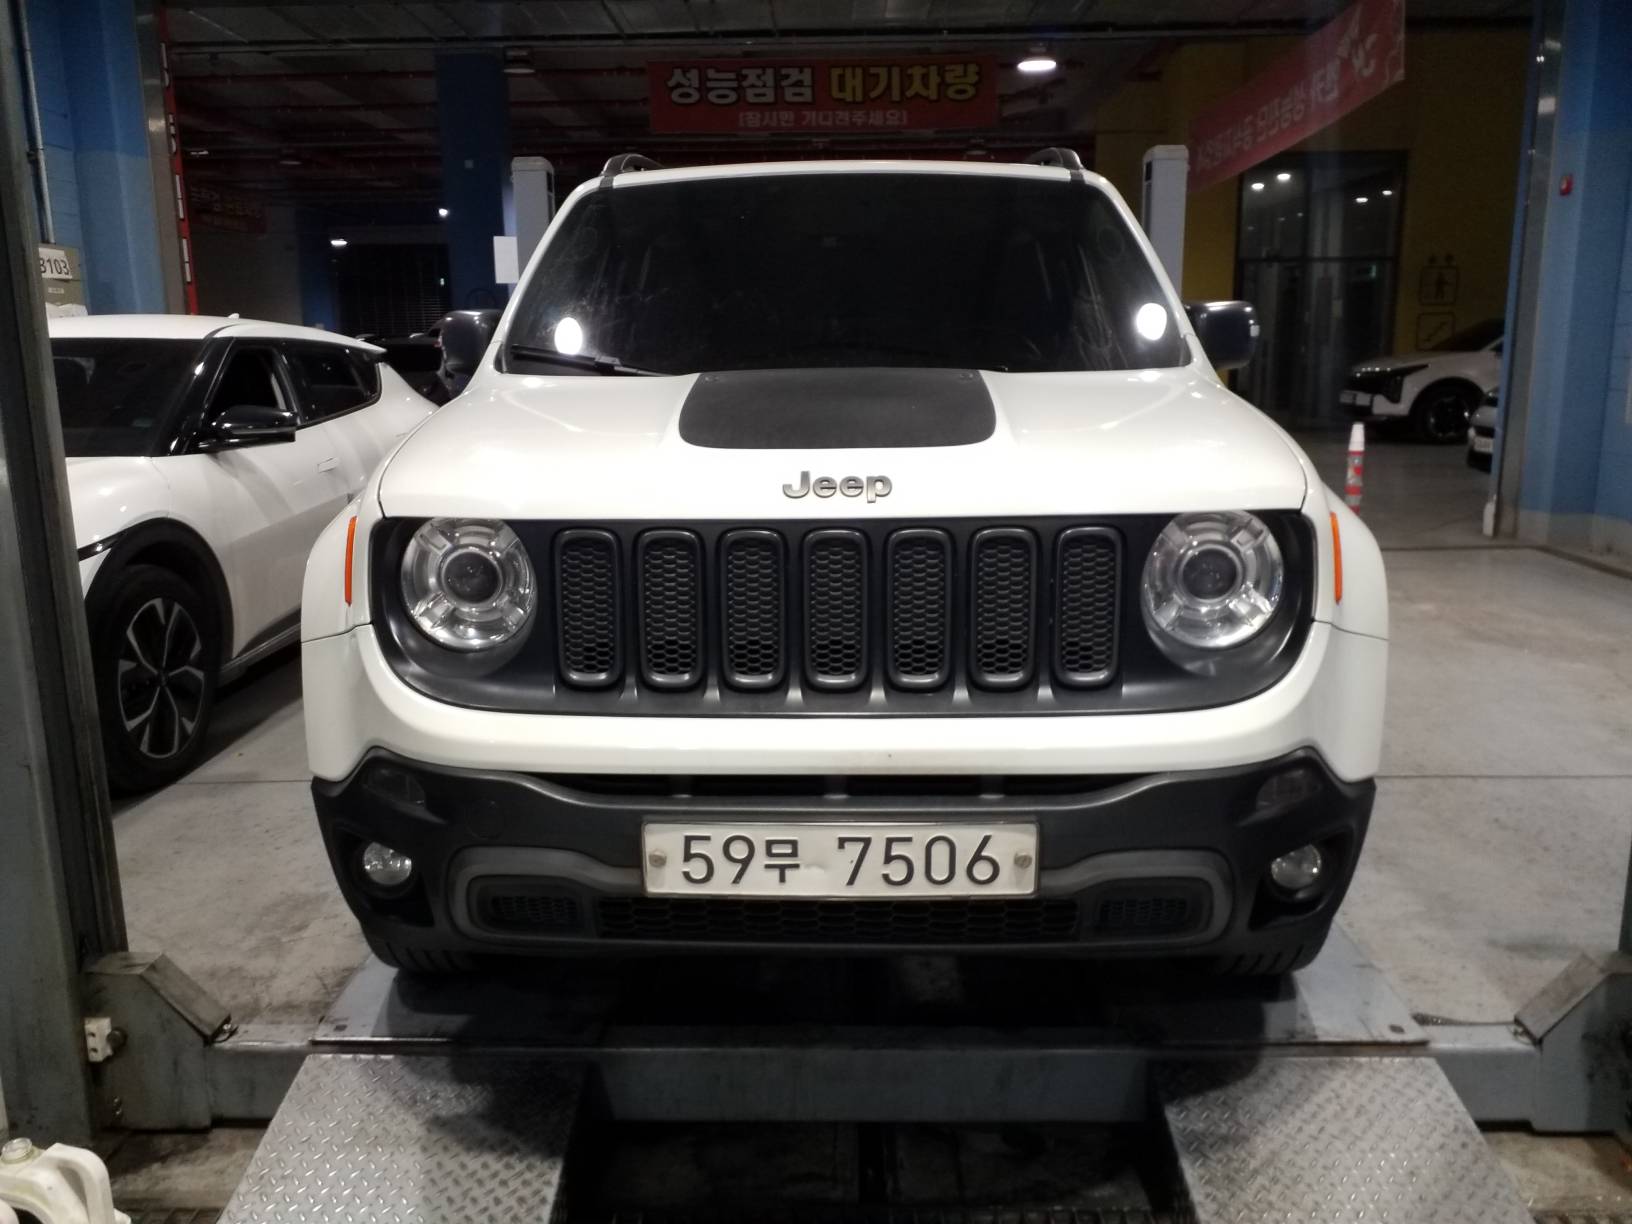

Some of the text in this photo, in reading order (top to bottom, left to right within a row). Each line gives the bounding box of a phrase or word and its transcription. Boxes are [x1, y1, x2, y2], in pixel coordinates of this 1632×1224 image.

[666, 63, 981, 105] 성능점검 대기차량
[782, 470, 892, 503] Jeep
[681, 834, 1001, 886] 59무 7506
